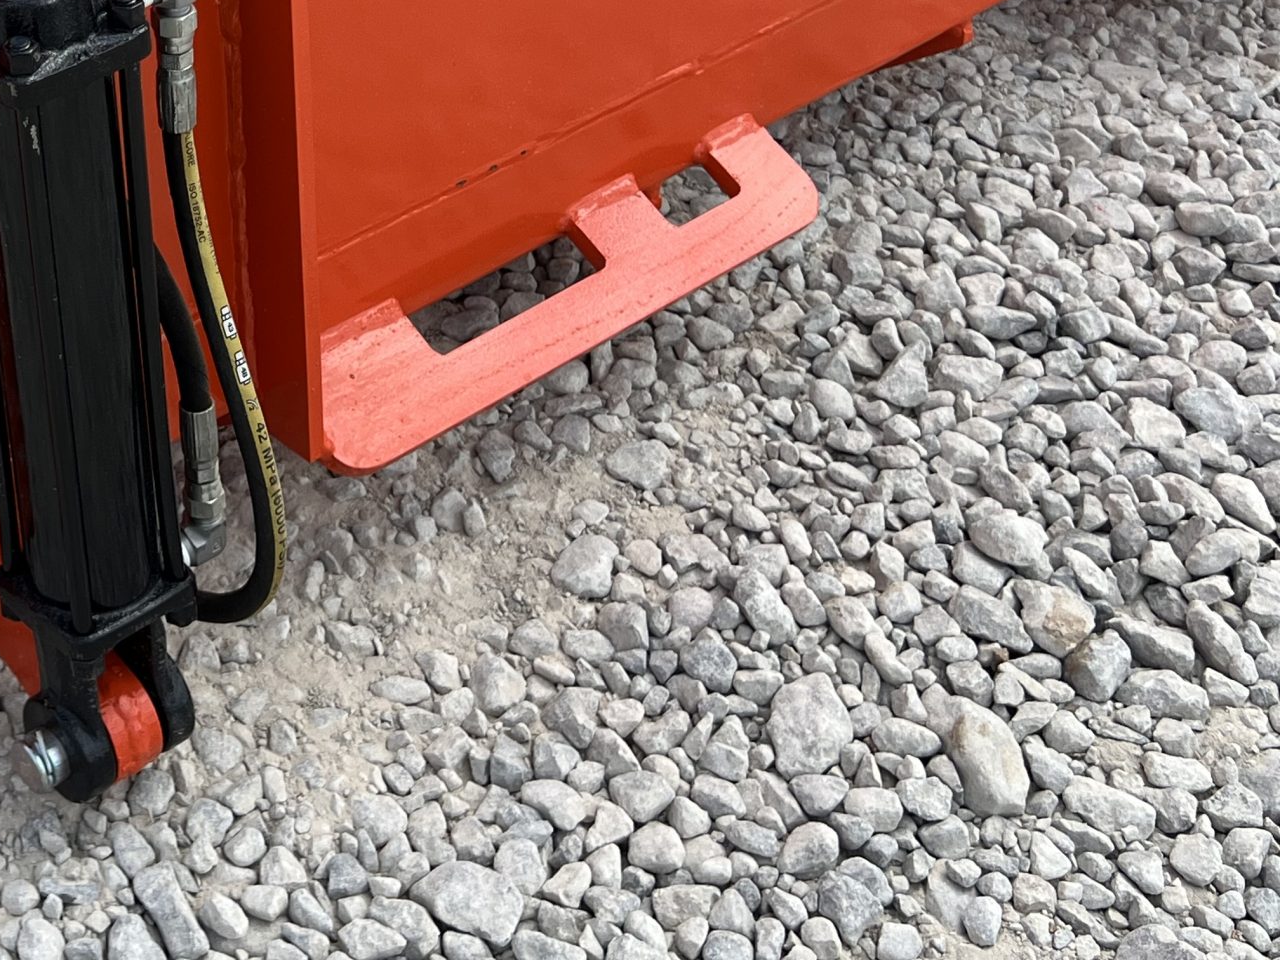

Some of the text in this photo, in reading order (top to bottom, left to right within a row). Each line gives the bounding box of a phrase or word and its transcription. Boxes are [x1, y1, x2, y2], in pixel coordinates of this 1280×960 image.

[188, 182, 197, 199] ISO
[192, 200, 206, 244] 18752-AC
[256, 422, 268, 444] 42
[262, 448, 277, 486] MPa
